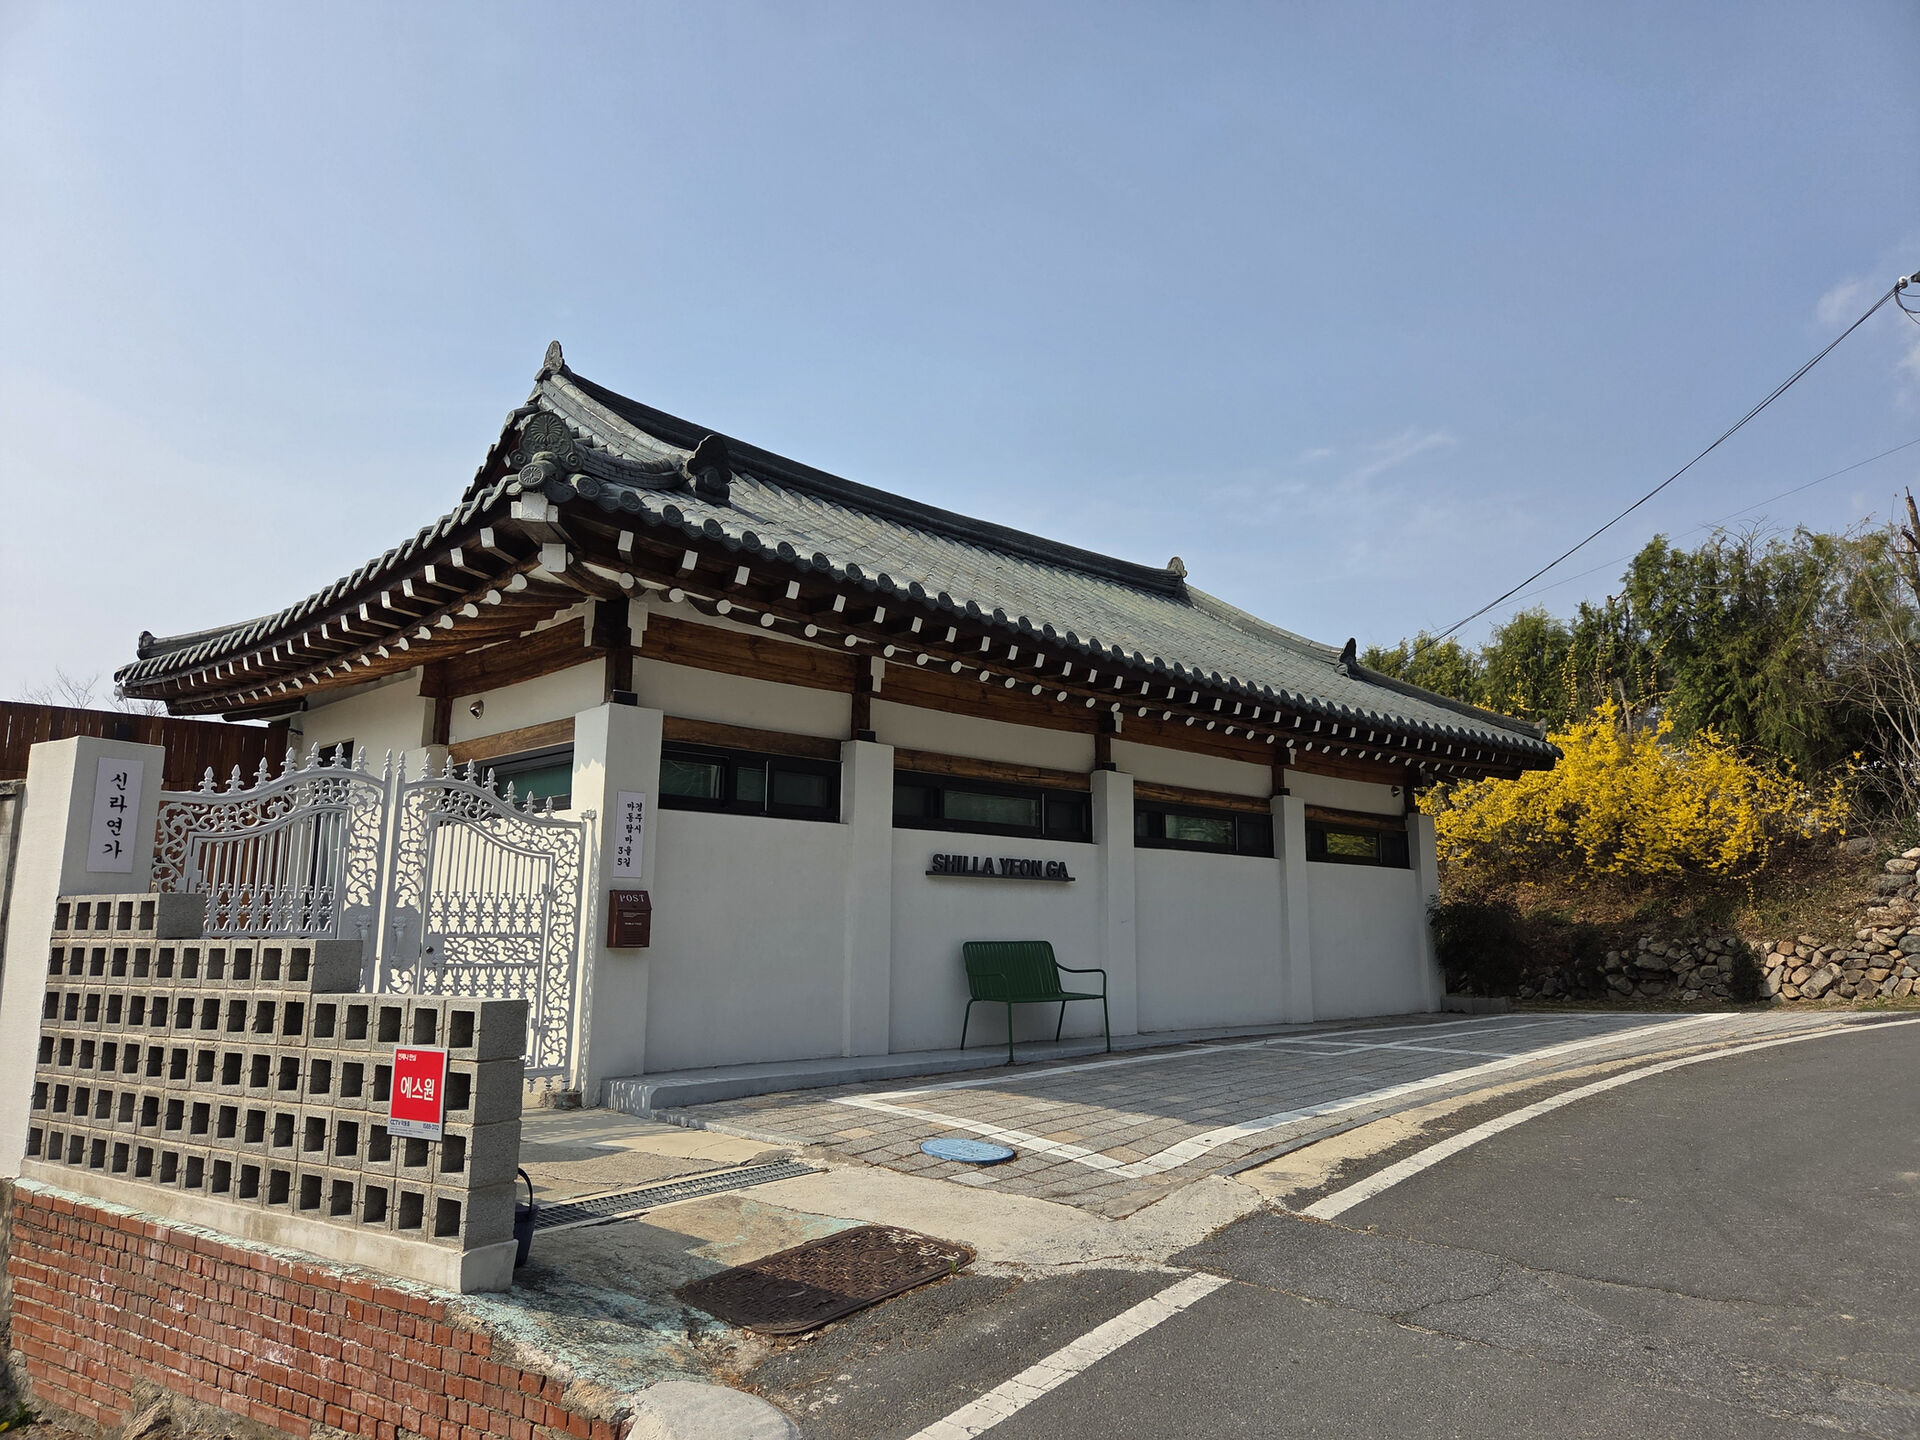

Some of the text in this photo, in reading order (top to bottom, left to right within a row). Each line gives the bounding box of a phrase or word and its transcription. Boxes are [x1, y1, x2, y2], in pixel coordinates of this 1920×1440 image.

[102, 772, 128, 860] 신라연가
[634, 802, 643, 834] 경주시
[932, 853, 1069, 878] SHILLA YEON GA
[619, 894, 645, 903] POST
[400, 1076, 435, 1101] 에스원
